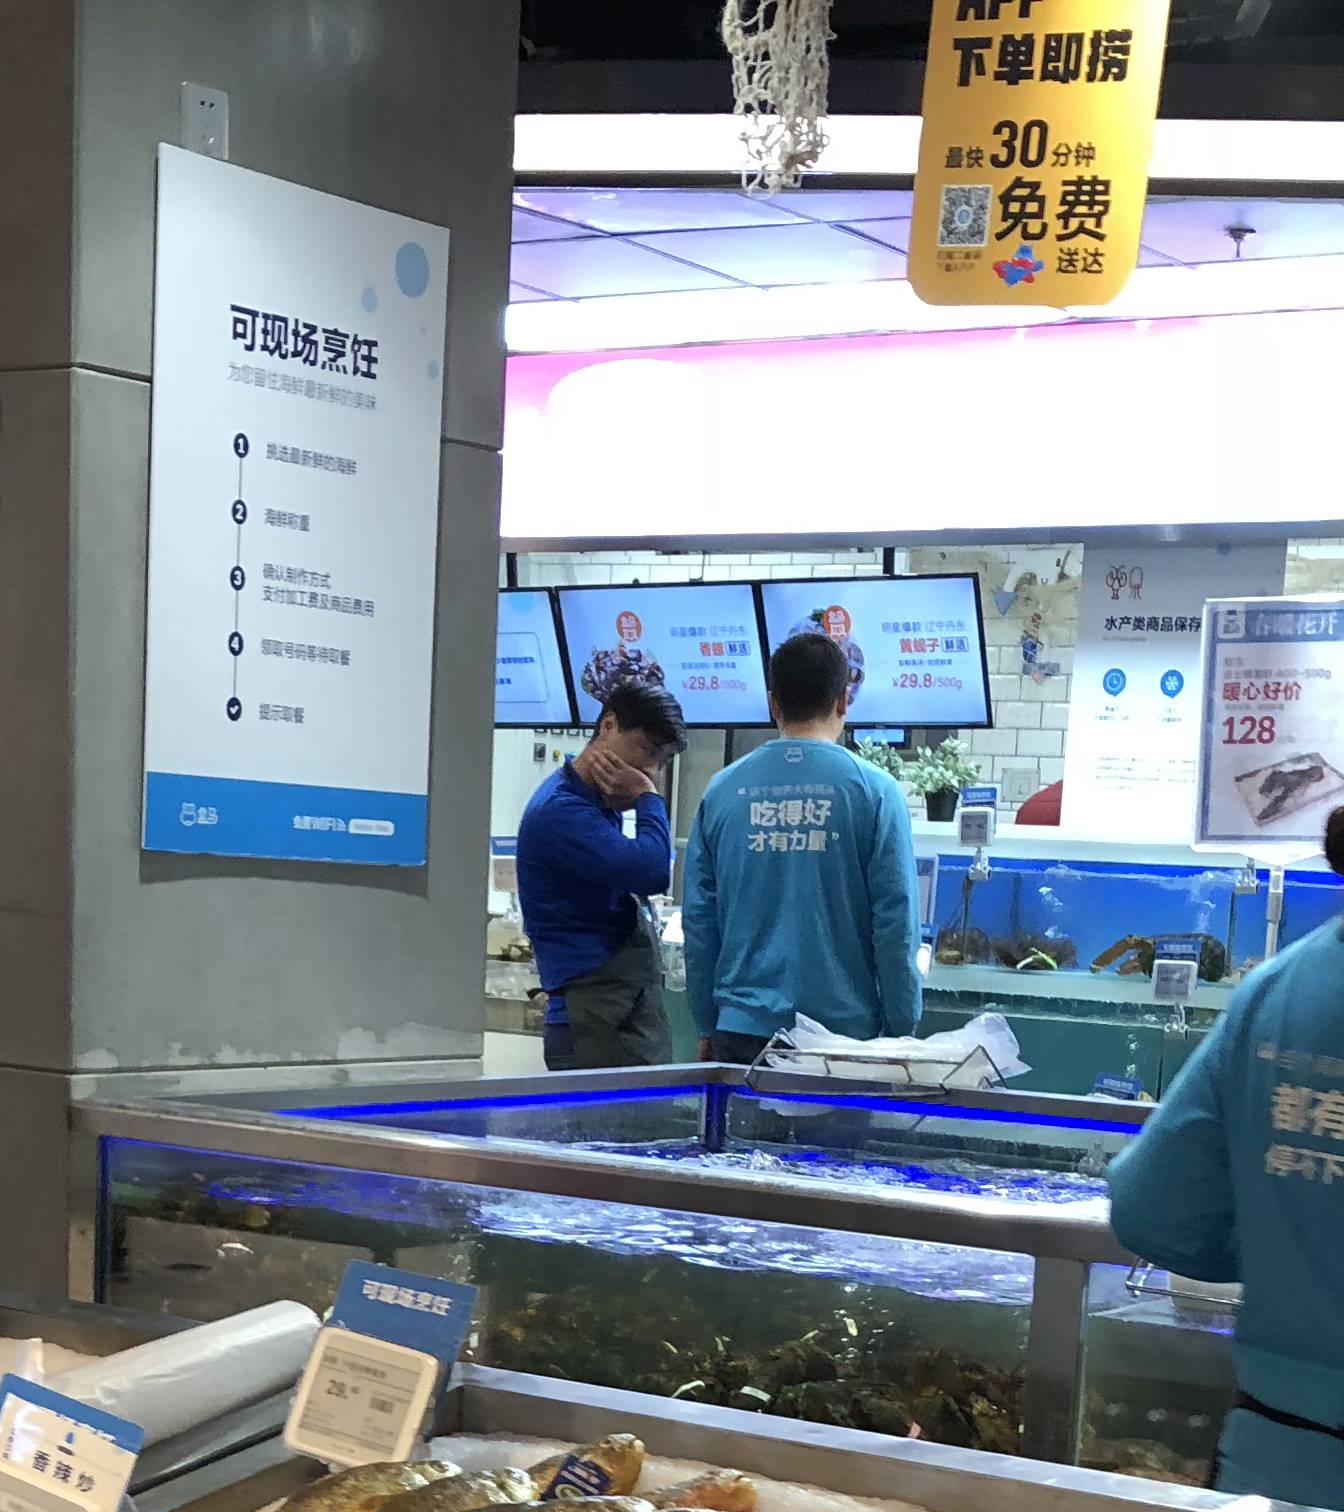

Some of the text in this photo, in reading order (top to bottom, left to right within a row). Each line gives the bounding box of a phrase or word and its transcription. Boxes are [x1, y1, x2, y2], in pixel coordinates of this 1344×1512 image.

[953, 29, 1132, 86] 下单即捞
[994, 175, 1112, 242] 免费
[1055, 247, 1105, 274] 送达
[230, 304, 379, 380] 可现场烹饪
[1104, 615, 1201, 633] 水产类商品保存
[1222, 680, 1302, 701] 暖心好价
[1222, 715, 1276, 745] 128
[750, 798, 832, 827] 吃得好
